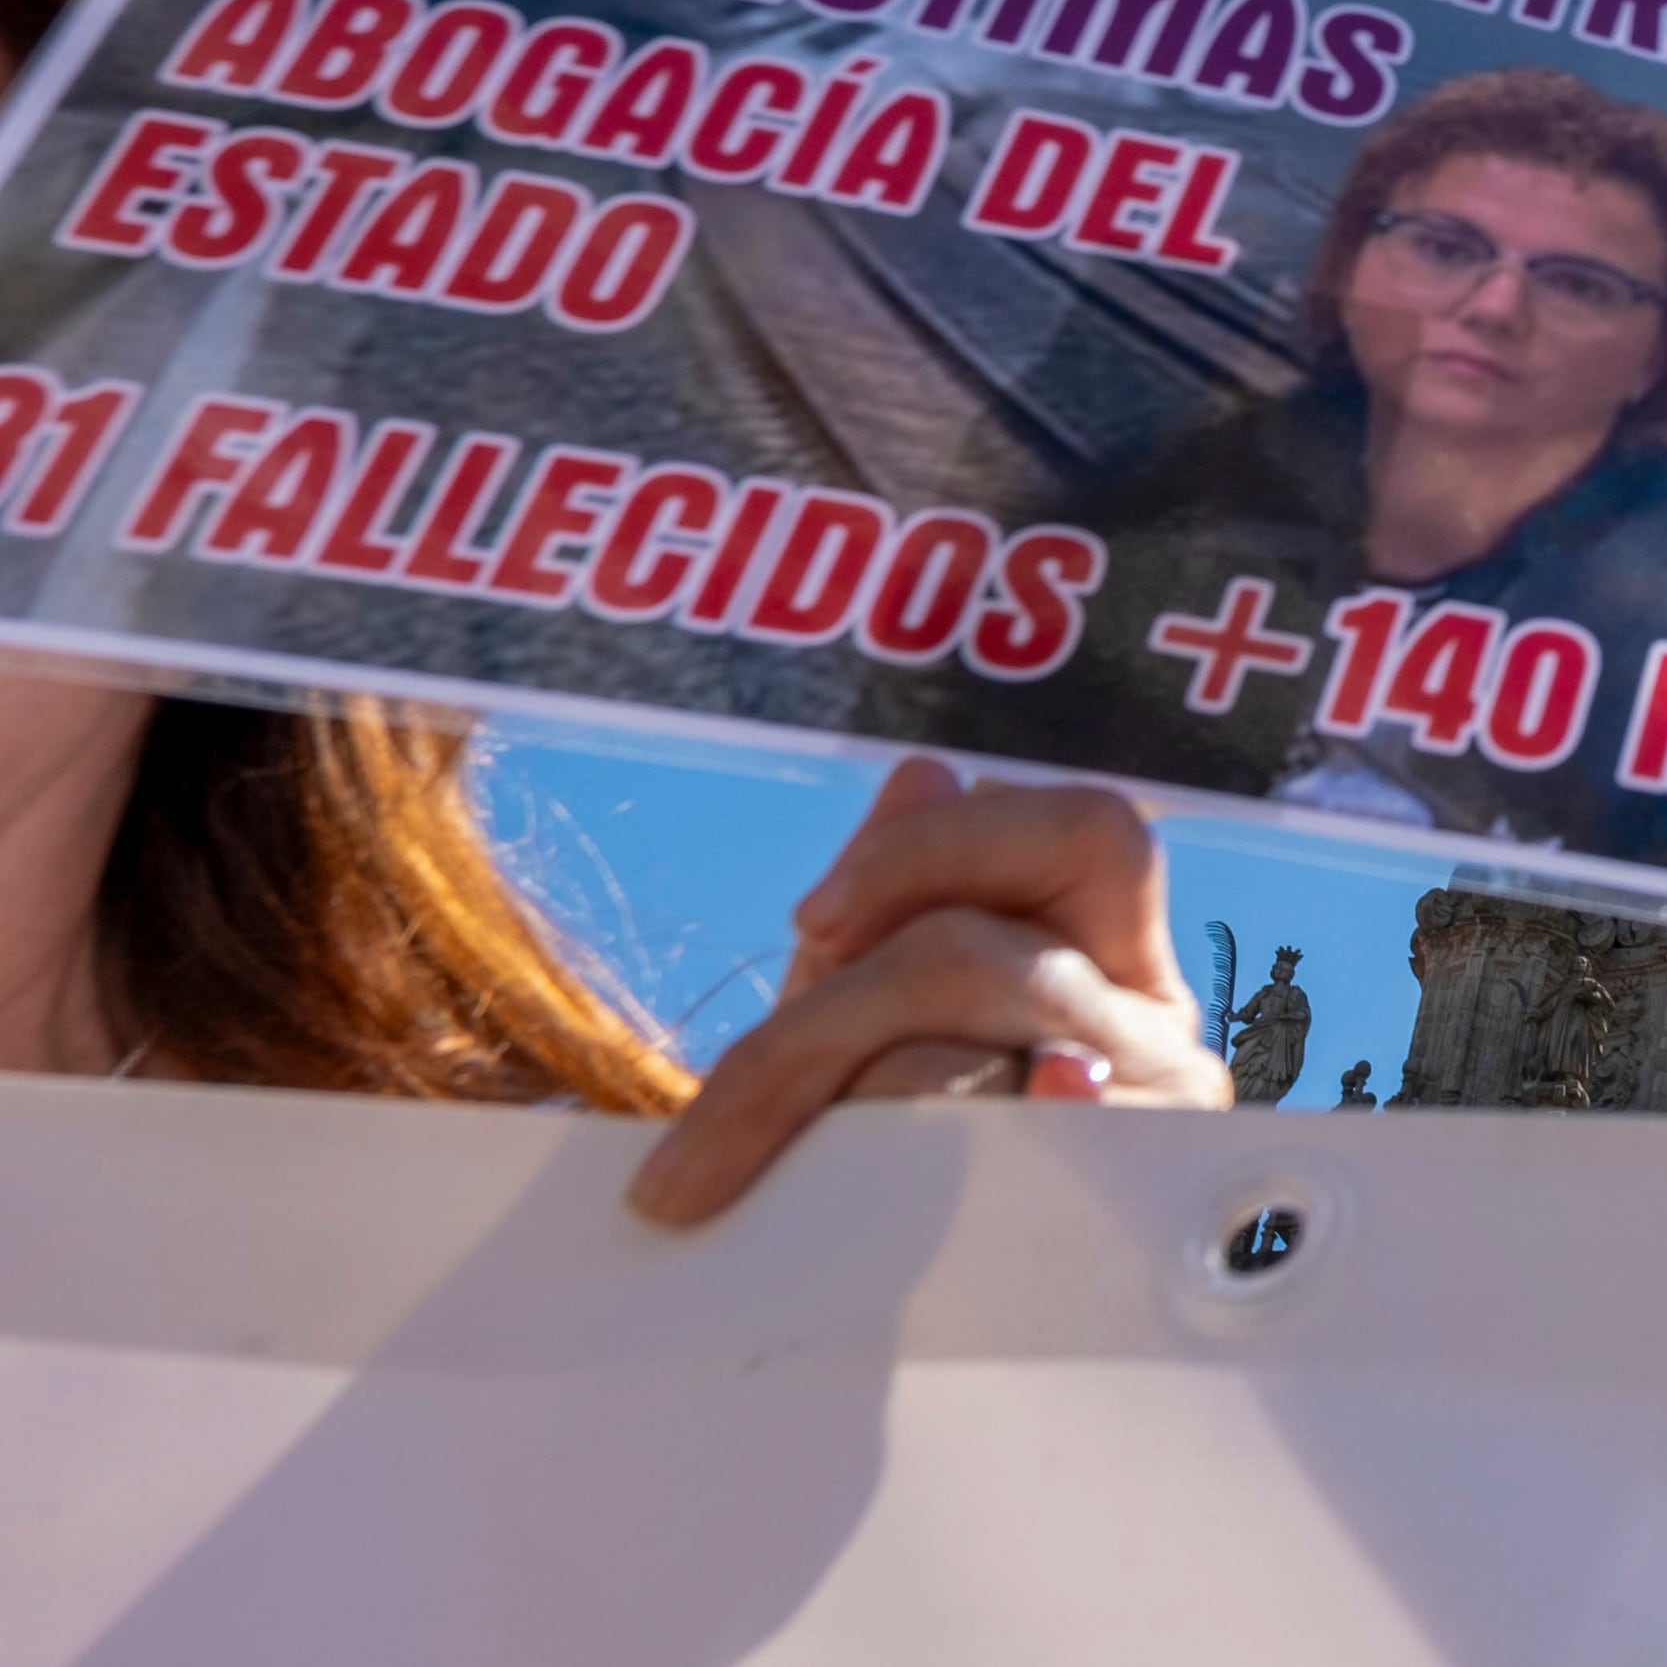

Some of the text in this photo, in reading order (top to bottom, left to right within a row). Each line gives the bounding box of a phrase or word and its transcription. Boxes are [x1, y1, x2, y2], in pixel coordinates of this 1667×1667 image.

[57, 109, 695, 333] ESTADO
[967, 108, 1239, 274] DEL
[116, 386, 1108, 677] FALLECIDOS
